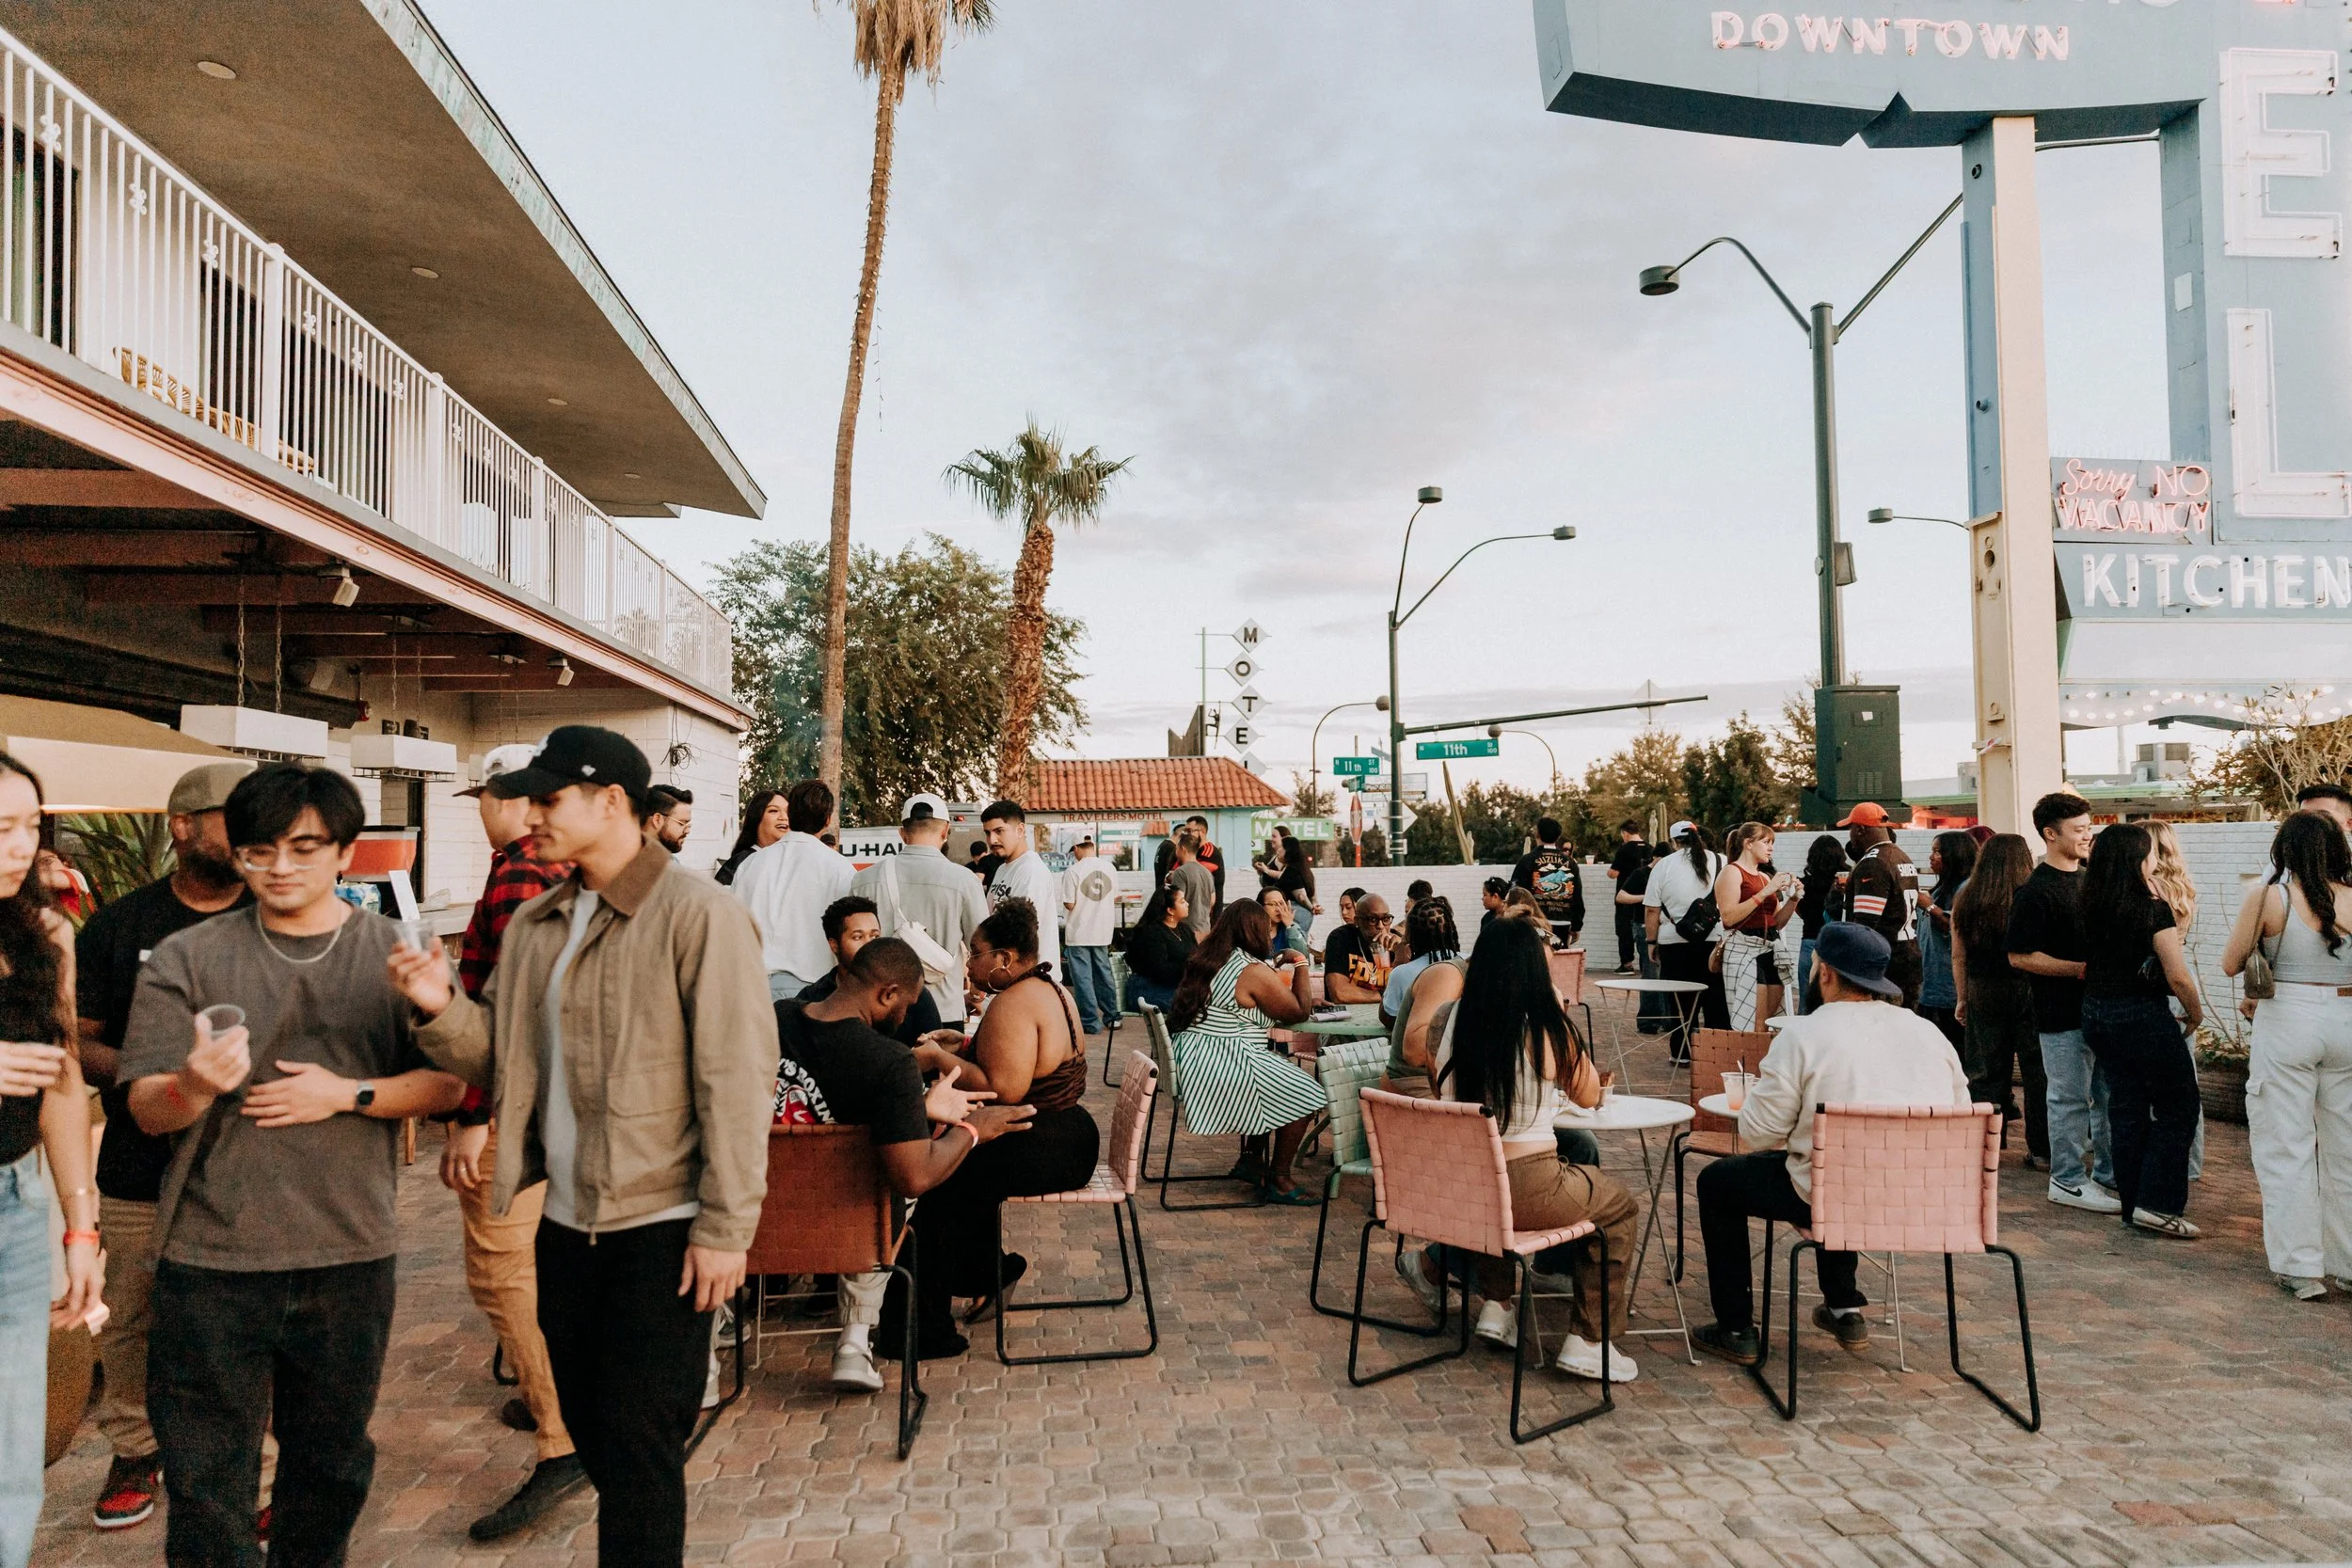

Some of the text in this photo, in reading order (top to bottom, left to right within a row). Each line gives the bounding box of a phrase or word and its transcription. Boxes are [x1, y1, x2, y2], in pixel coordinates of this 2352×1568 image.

[1711, 11, 2069, 61] DOWNTOWN
[2061, 458, 2209, 500] Sorry NO
[2054, 497, 2211, 534] VACANCY
[2082, 553, 2352, 610] KITCHEN
[1443, 743, 1468, 756] 11th
[1061, 811, 1165, 822] TRAVELERS MOTEL
[1254, 820, 1329, 838] MTEL
[840, 843, 903, 857] U-HA
[1534, 855, 1570, 869] SUZUKA
